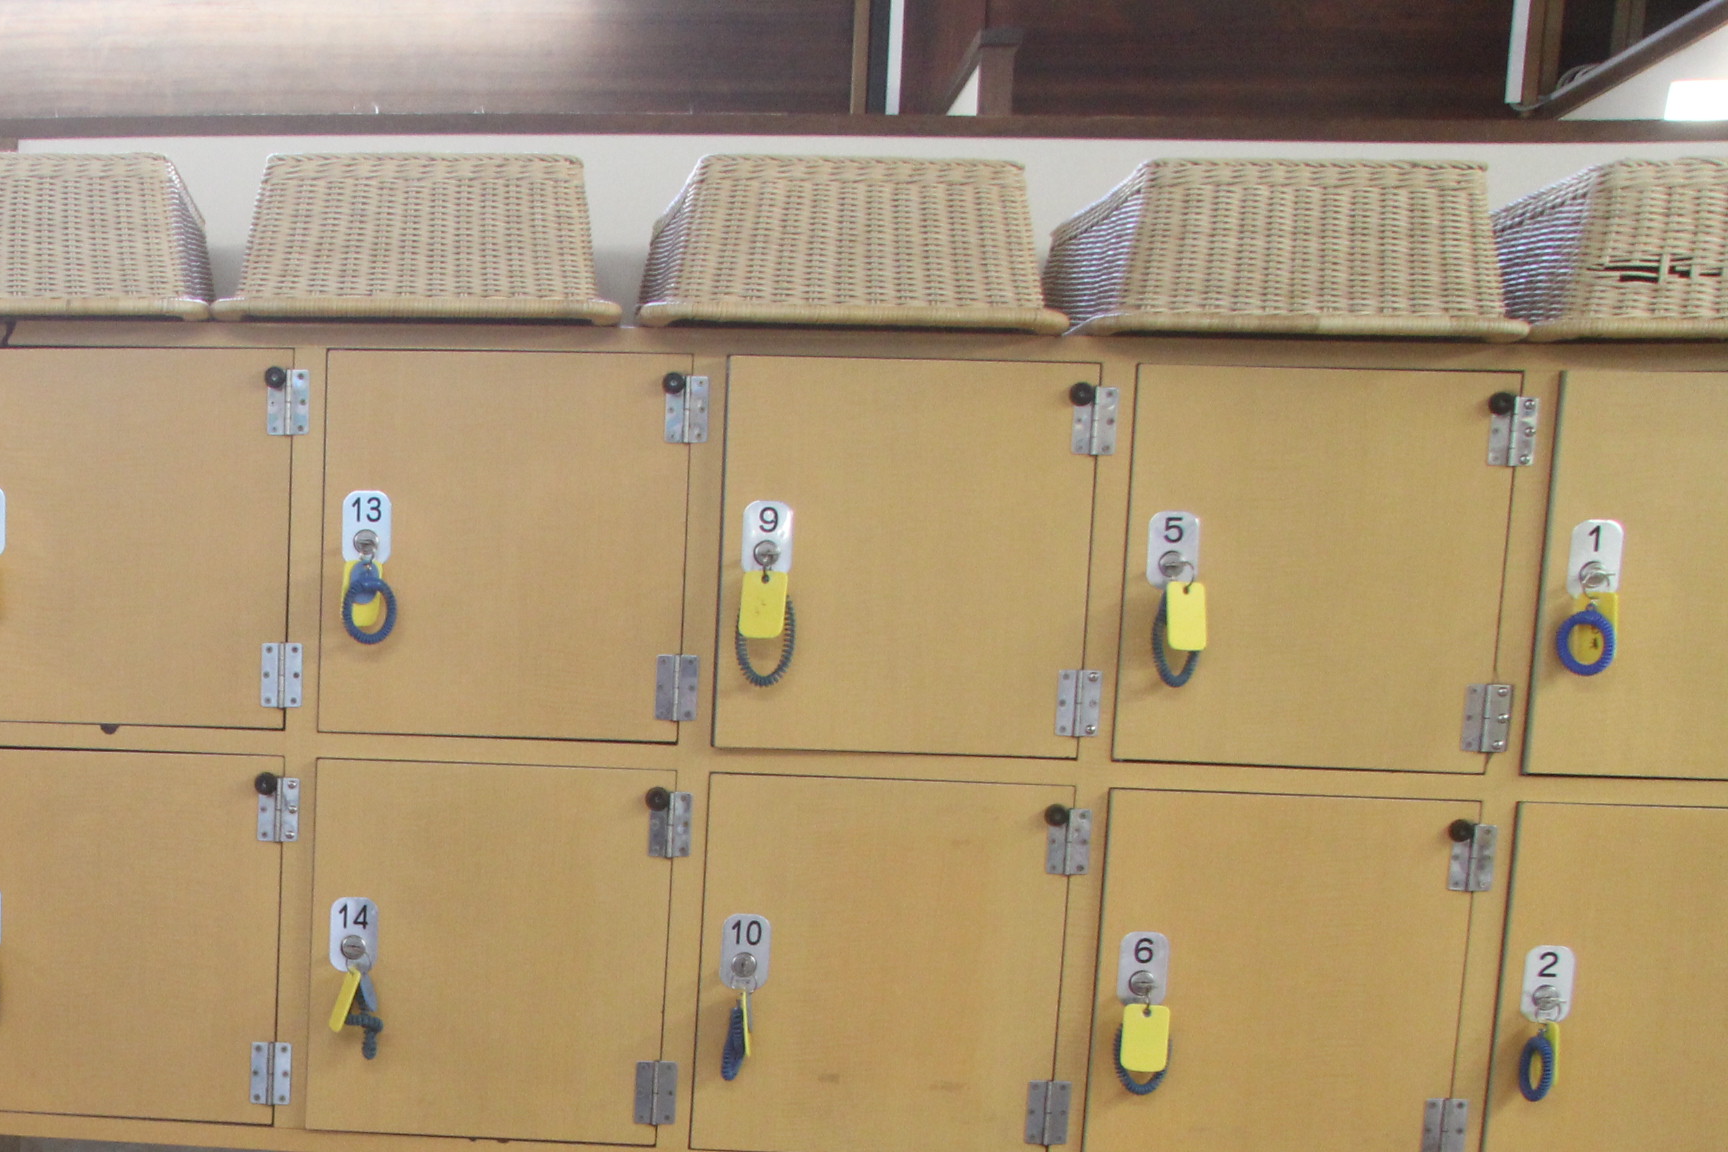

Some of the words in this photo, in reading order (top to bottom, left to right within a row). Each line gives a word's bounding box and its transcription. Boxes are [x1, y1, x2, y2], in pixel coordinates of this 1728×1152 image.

[352, 497, 382, 522] 13
[759, 507, 779, 531] 9
[1164, 517, 1184, 543] 5
[1588, 526, 1602, 552] 1
[338, 905, 369, 929] 14
[732, 920, 762, 945] 10
[1134, 939, 1154, 963] 6
[1539, 953, 1558, 977] 2
